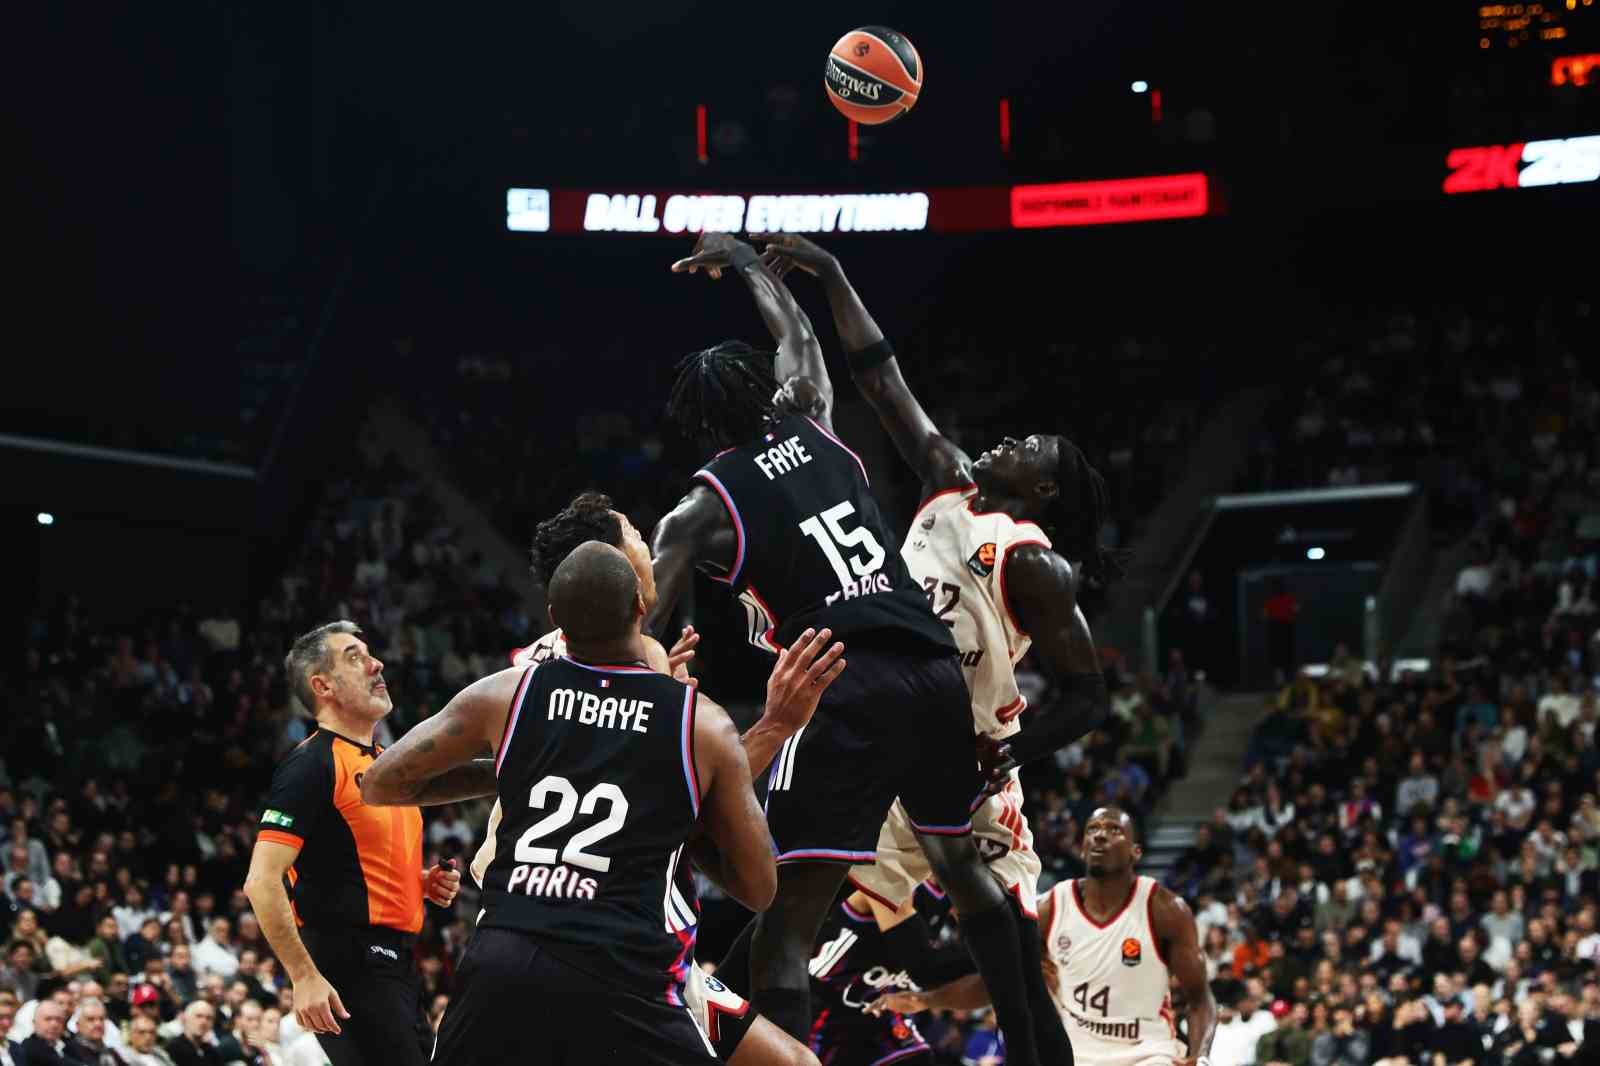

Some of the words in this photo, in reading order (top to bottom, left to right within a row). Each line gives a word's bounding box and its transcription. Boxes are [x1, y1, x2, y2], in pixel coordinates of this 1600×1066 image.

[584, 193, 660, 232] BALL
[663, 194, 746, 233] OVER
[746, 192, 929, 233] EVERYTHING
[753, 435, 812, 480] FAYE
[799, 500, 885, 586] 15
[548, 688, 653, 733] M'BAYE
[514, 775, 628, 873] 22
[507, 864, 599, 900] PARIS
[1073, 982, 1110, 1018] 44
